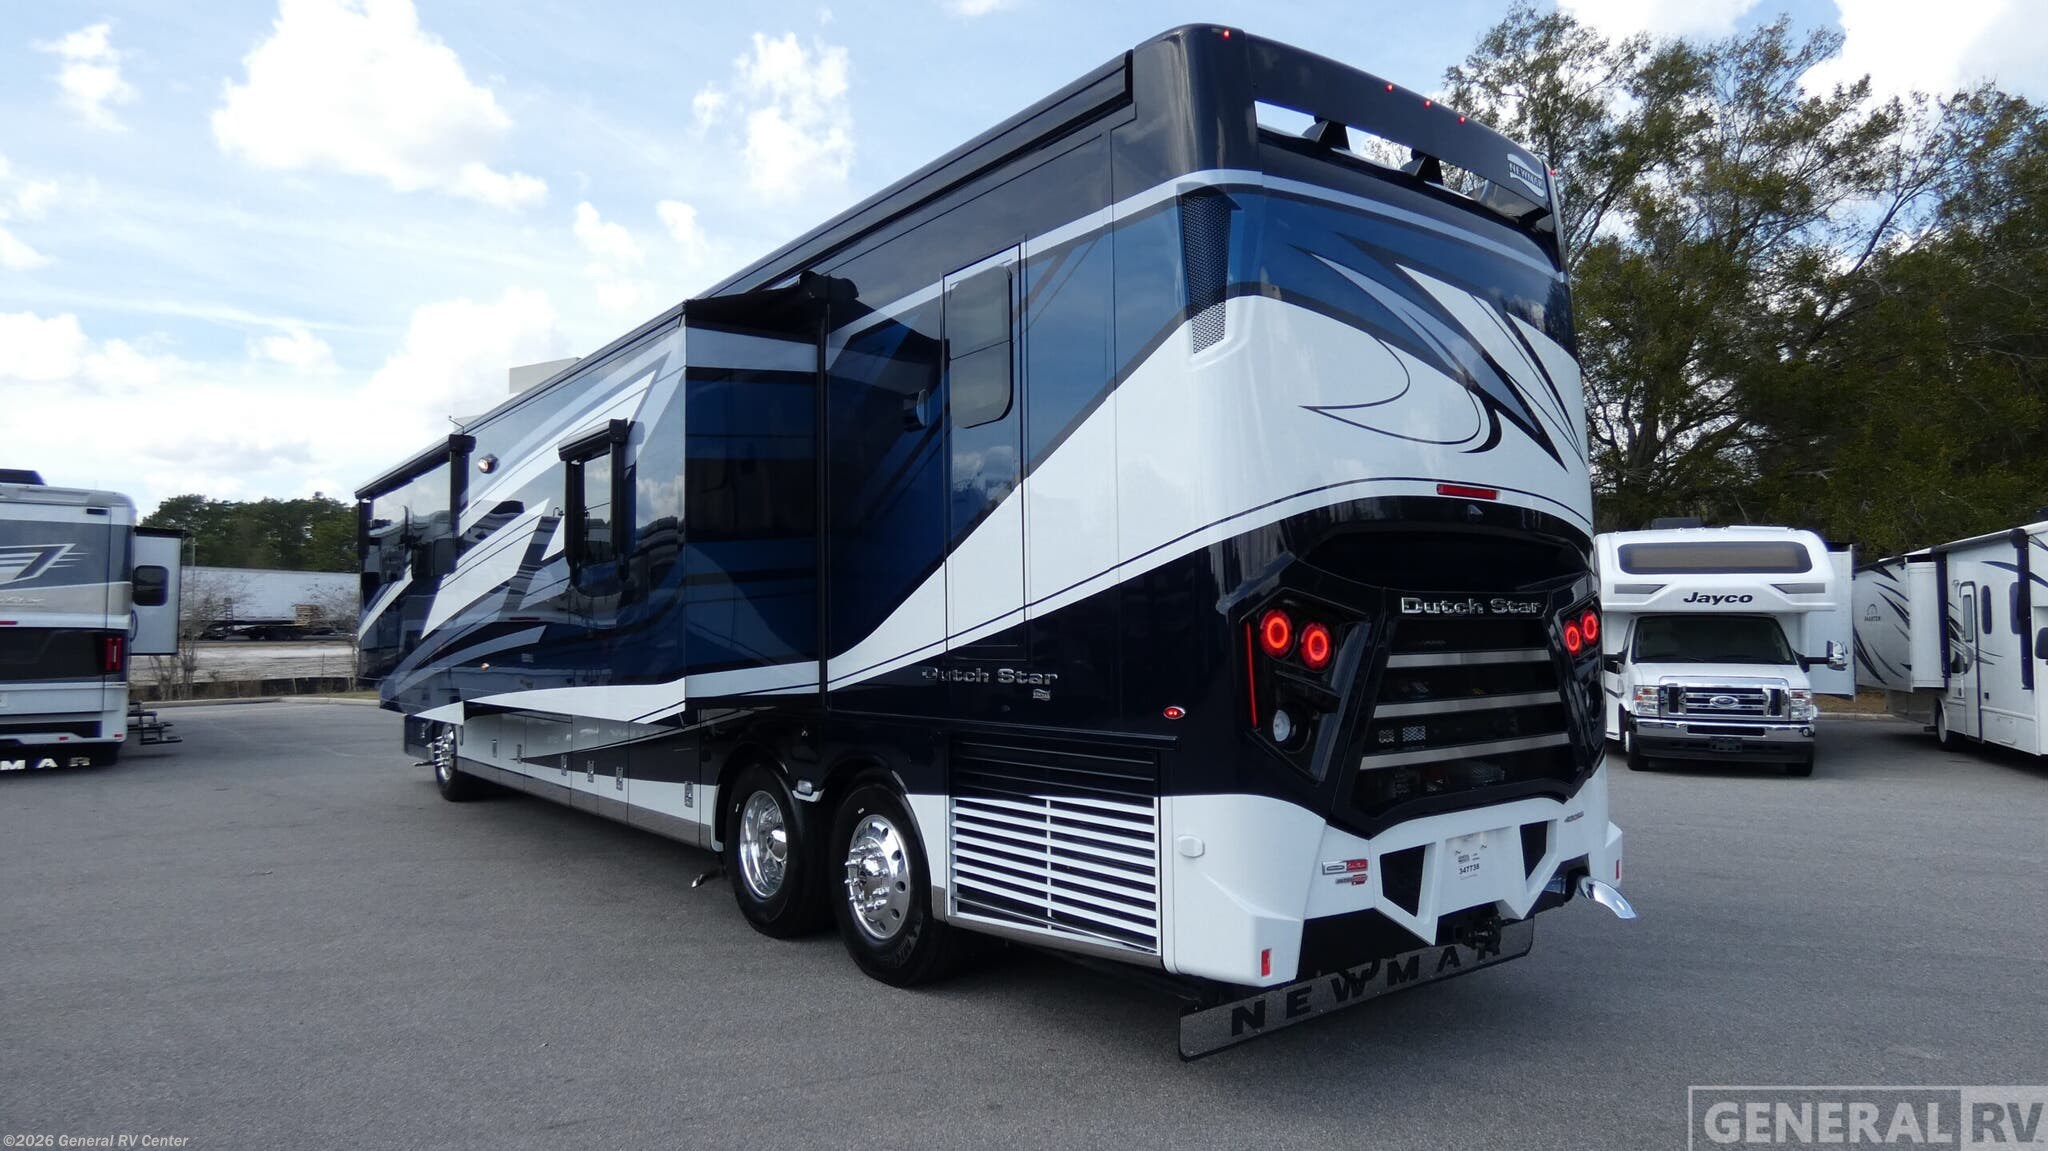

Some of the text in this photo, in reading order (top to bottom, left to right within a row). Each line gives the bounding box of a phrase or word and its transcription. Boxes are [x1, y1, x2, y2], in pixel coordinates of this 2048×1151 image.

[1401, 597, 1541, 614] Dutch Star
[1683, 591, 1753, 605] Jayco
[997, 668, 1058, 685] Star
